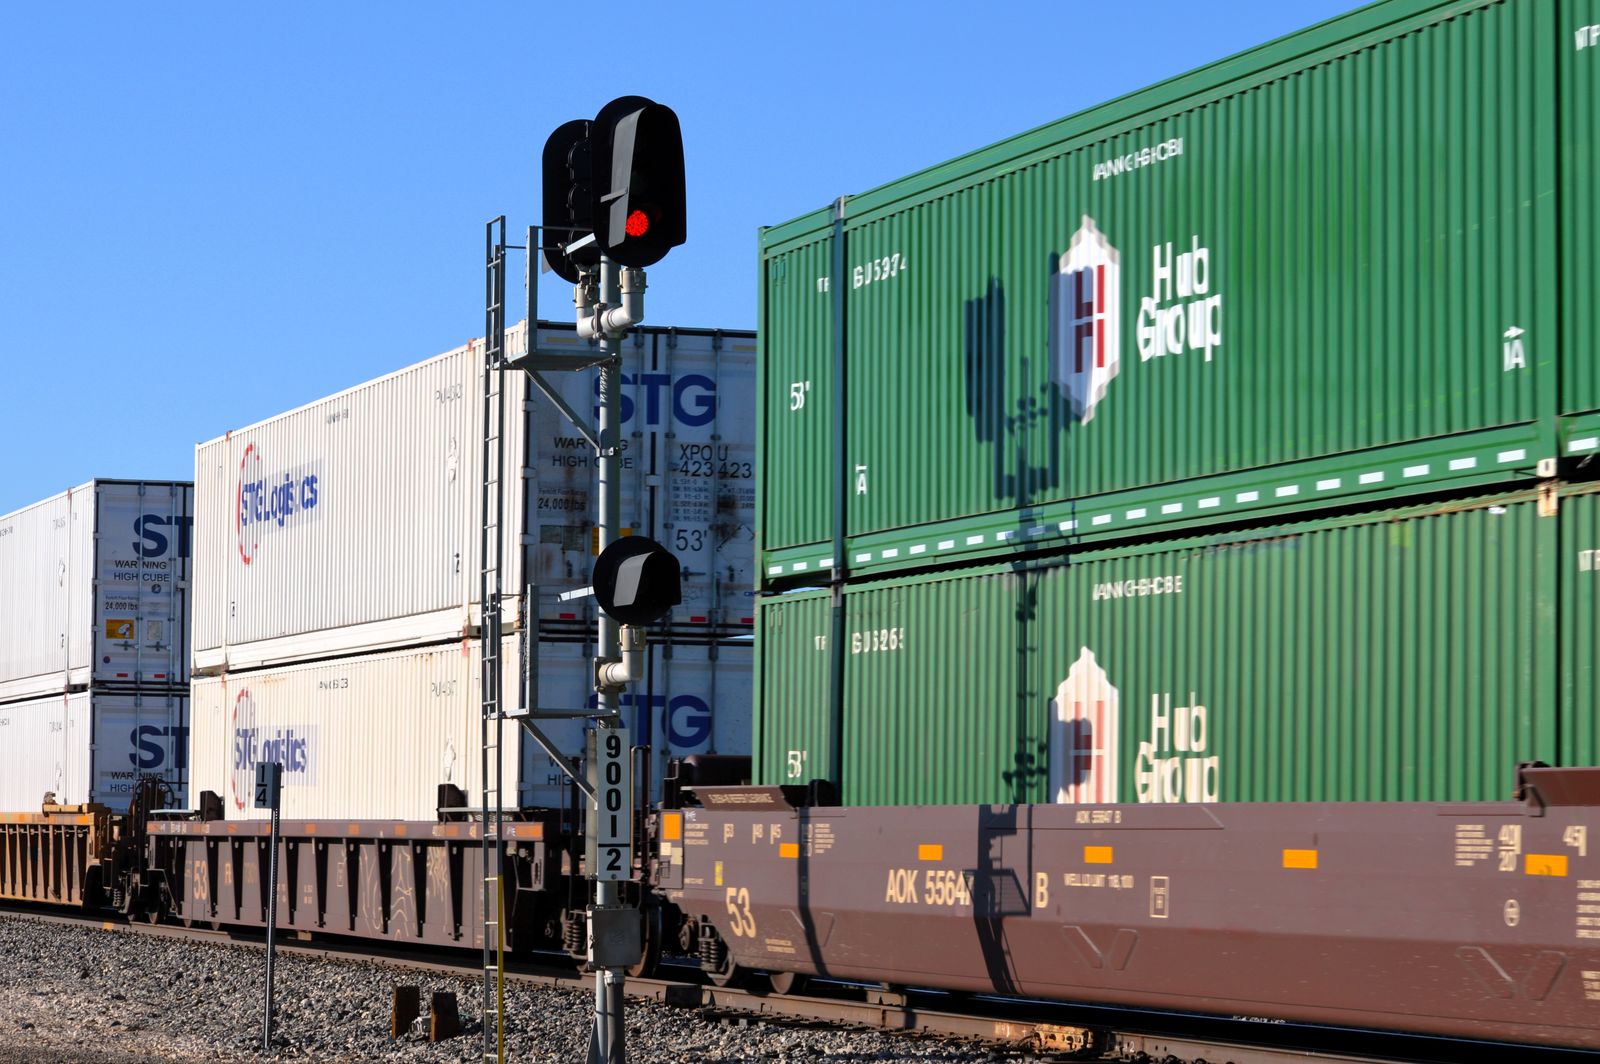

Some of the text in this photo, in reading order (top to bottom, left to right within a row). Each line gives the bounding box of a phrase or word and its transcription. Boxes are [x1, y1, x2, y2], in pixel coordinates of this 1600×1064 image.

[1153, 235, 1210, 303] Hub
[1136, 293, 1222, 363] Group
[593, 373, 717, 427] STG
[552, 455, 588, 468] HIGH
[132, 513, 194, 559] ST
[675, 529, 707, 552] 53'
[113, 572, 170, 582] HIGH CUBE
[1151, 691, 1207, 752] Hub
[128, 724, 189, 769] ST
[1134, 741, 1219, 803] Group
[255, 788, 268, 806] 4
[193, 860, 208, 901] 53
[885, 868, 918, 905] AOK
[1035, 872, 1050, 909] B
[725, 886, 757, 939] 53
